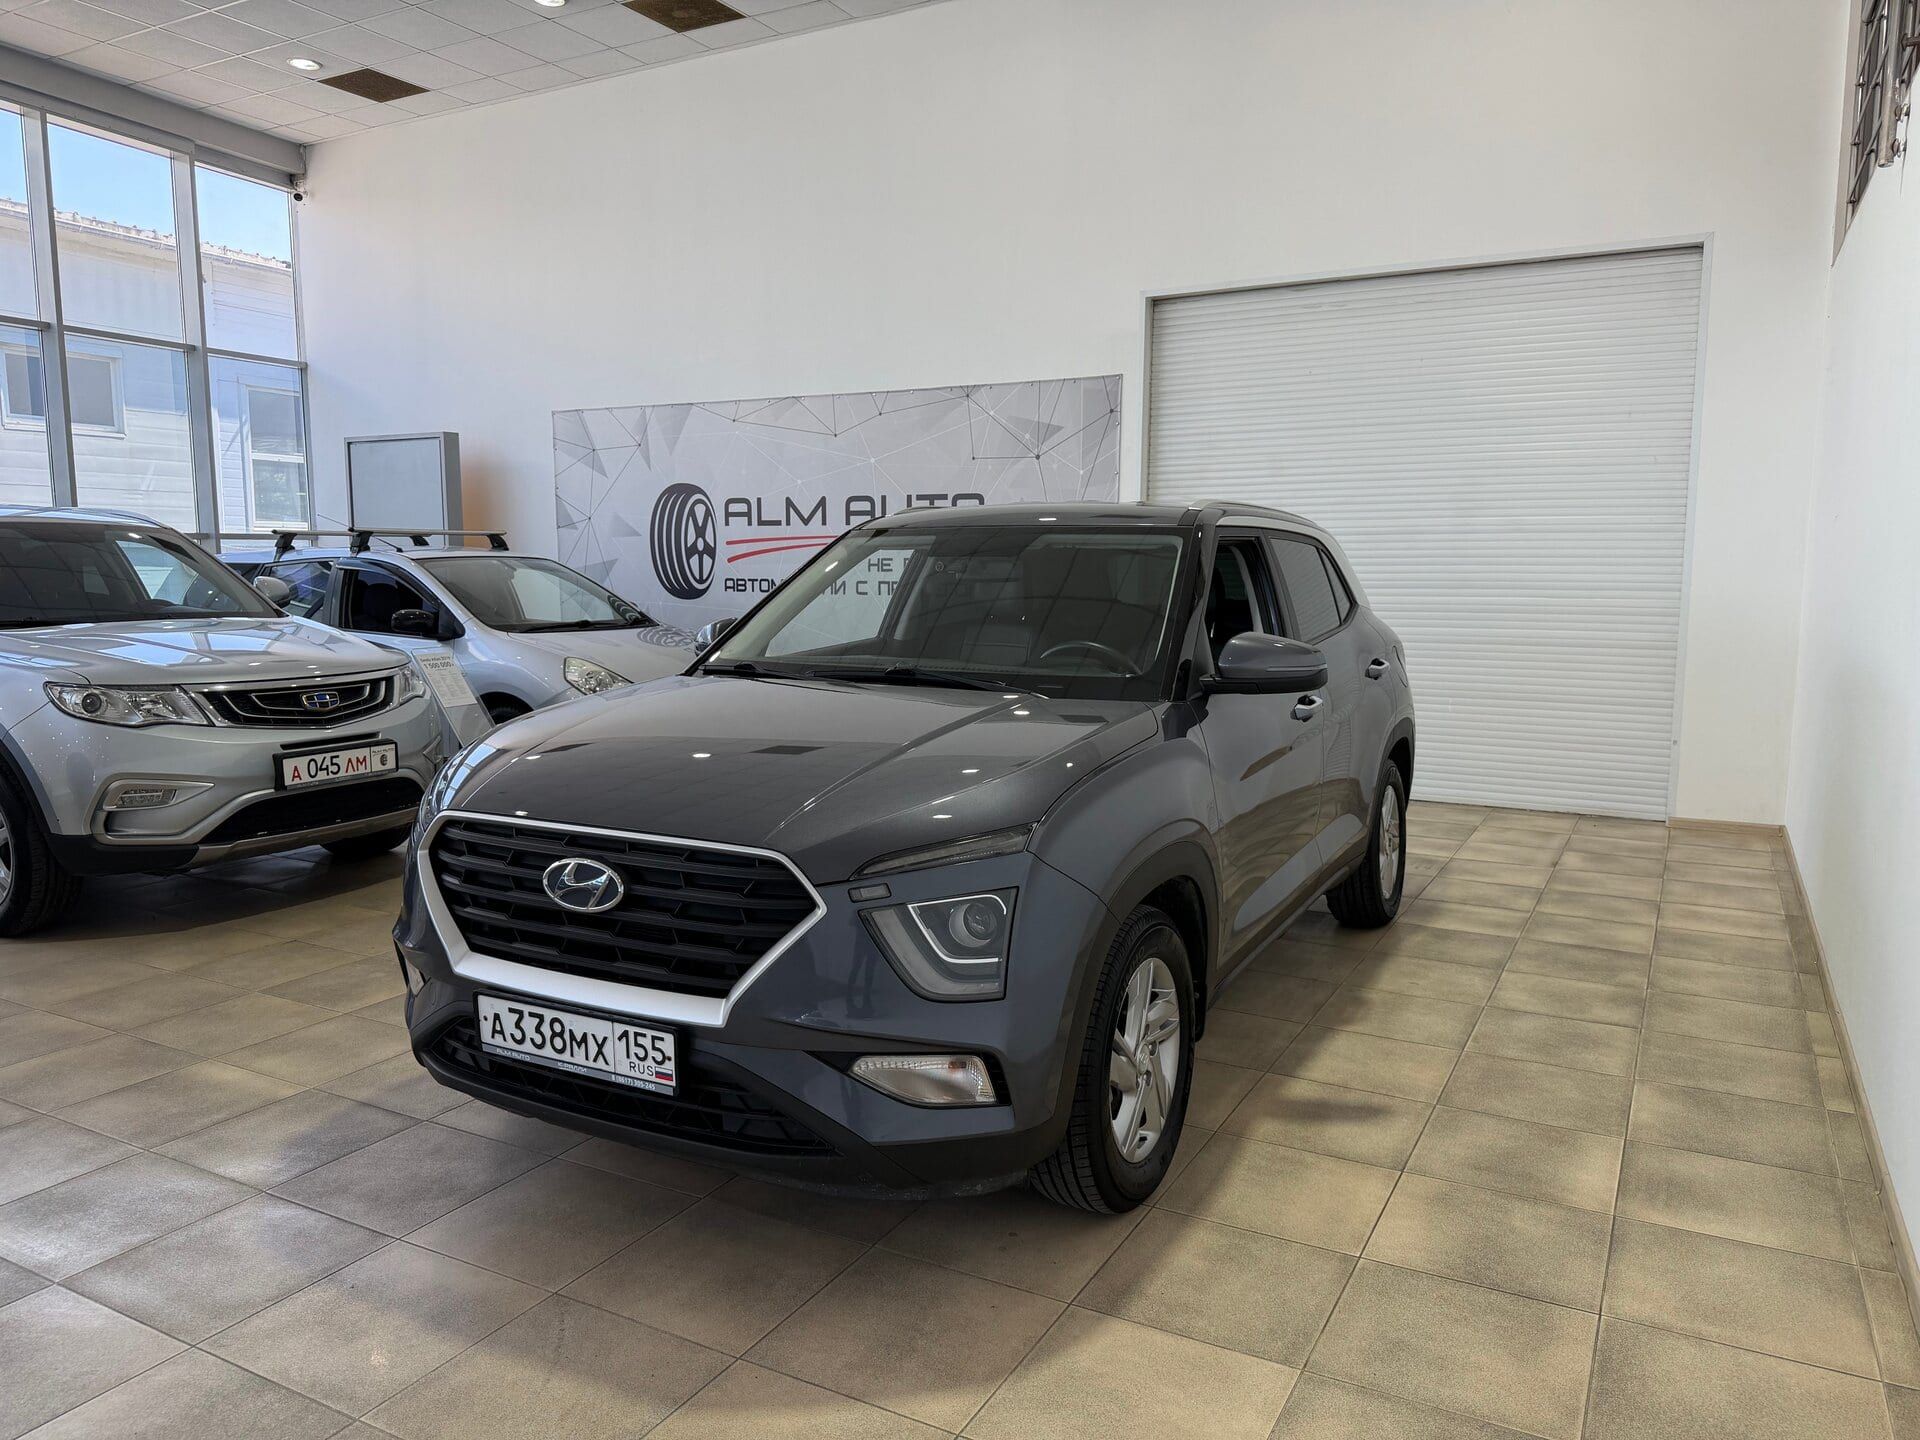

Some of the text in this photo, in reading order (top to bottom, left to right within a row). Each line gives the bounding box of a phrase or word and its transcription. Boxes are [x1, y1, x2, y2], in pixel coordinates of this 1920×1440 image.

[724, 495, 827, 527] ALM
[867, 557, 893, 573] НЕ
[291, 765, 302, 782] А
[307, 755, 341, 779] 045
[490, 1007, 667, 1066] А338МХ 155
[629, 1061, 654, 1077] RUS
